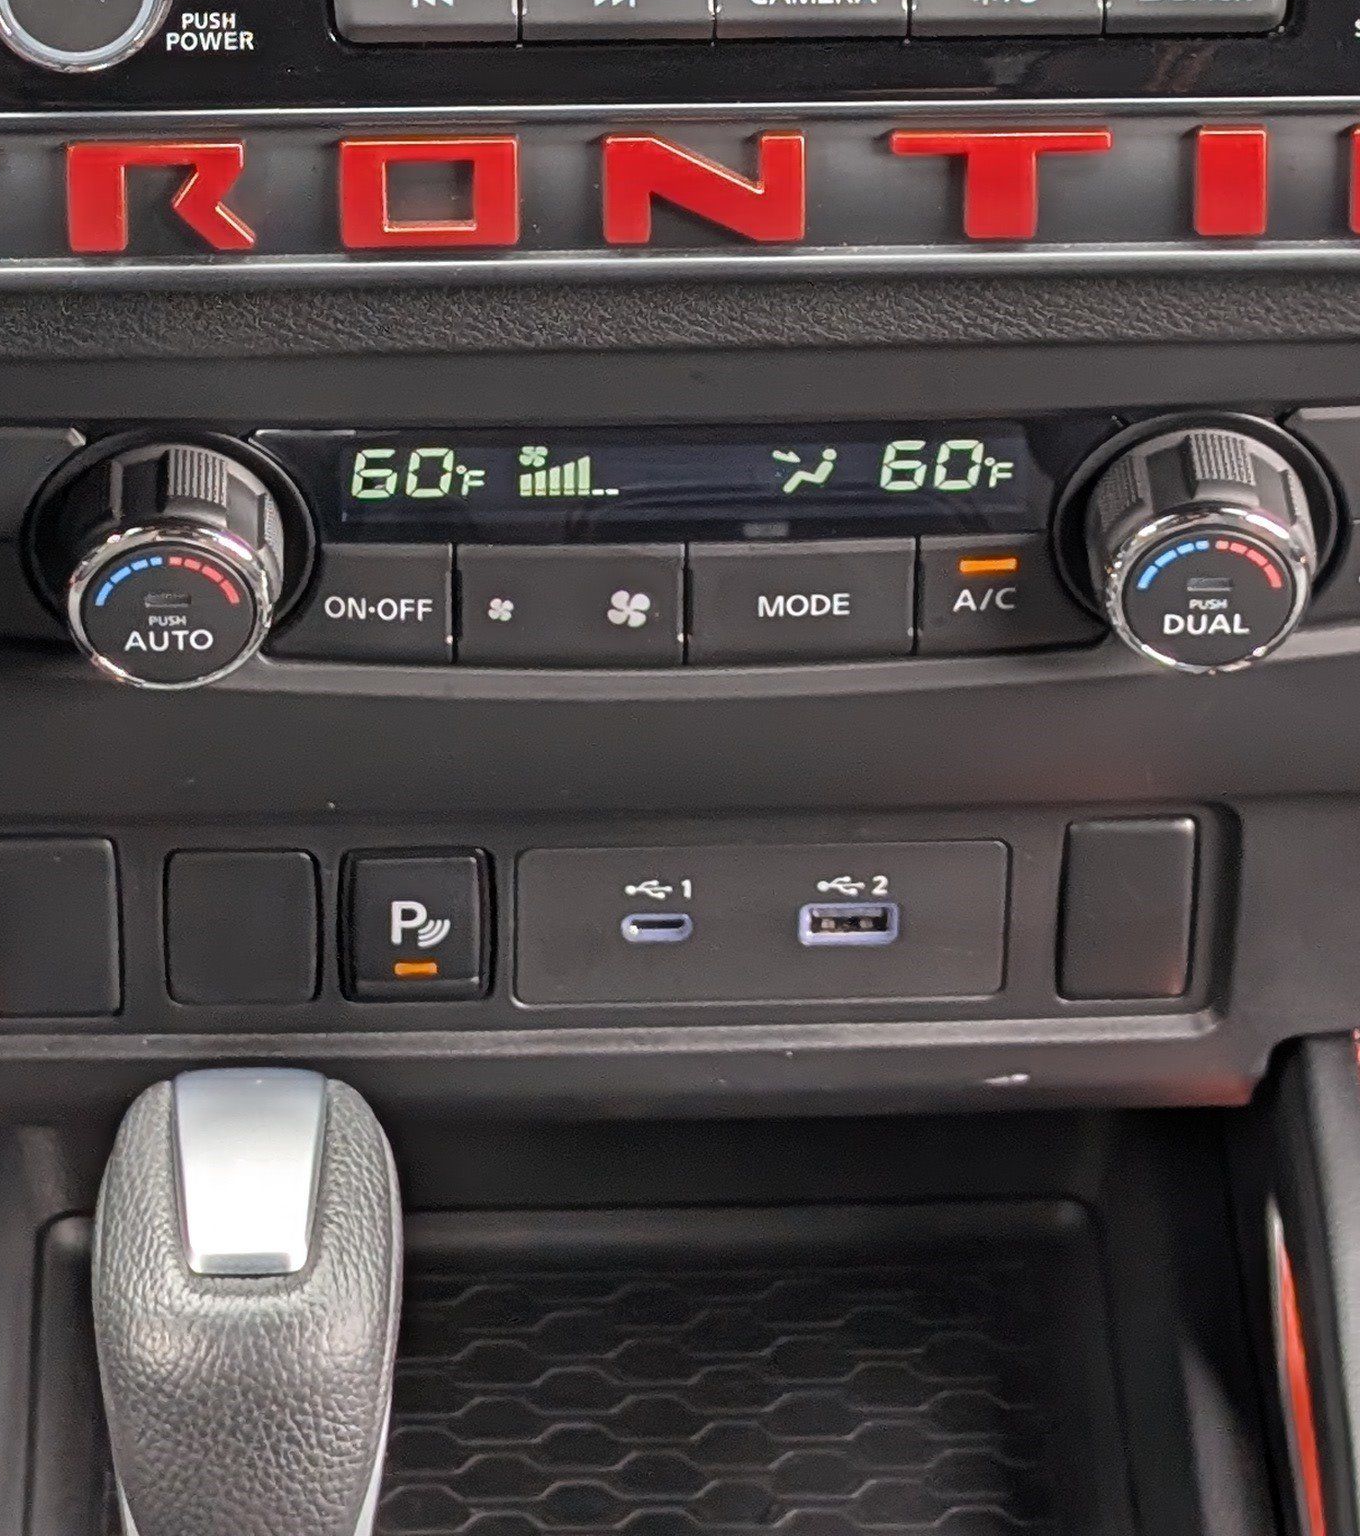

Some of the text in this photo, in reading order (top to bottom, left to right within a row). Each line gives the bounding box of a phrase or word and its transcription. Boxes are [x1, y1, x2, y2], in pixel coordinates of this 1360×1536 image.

[181, 11, 237, 30] PUSH
[166, 32, 254, 51] POWER
[757, 593, 851, 618] MODE
[953, 588, 1017, 612] A/C
[1189, 599, 1227, 610] PUSH
[148, 615, 187, 626] PUSH
[1163, 614, 1250, 635] DUAL
[125, 630, 214, 652] AUTO
